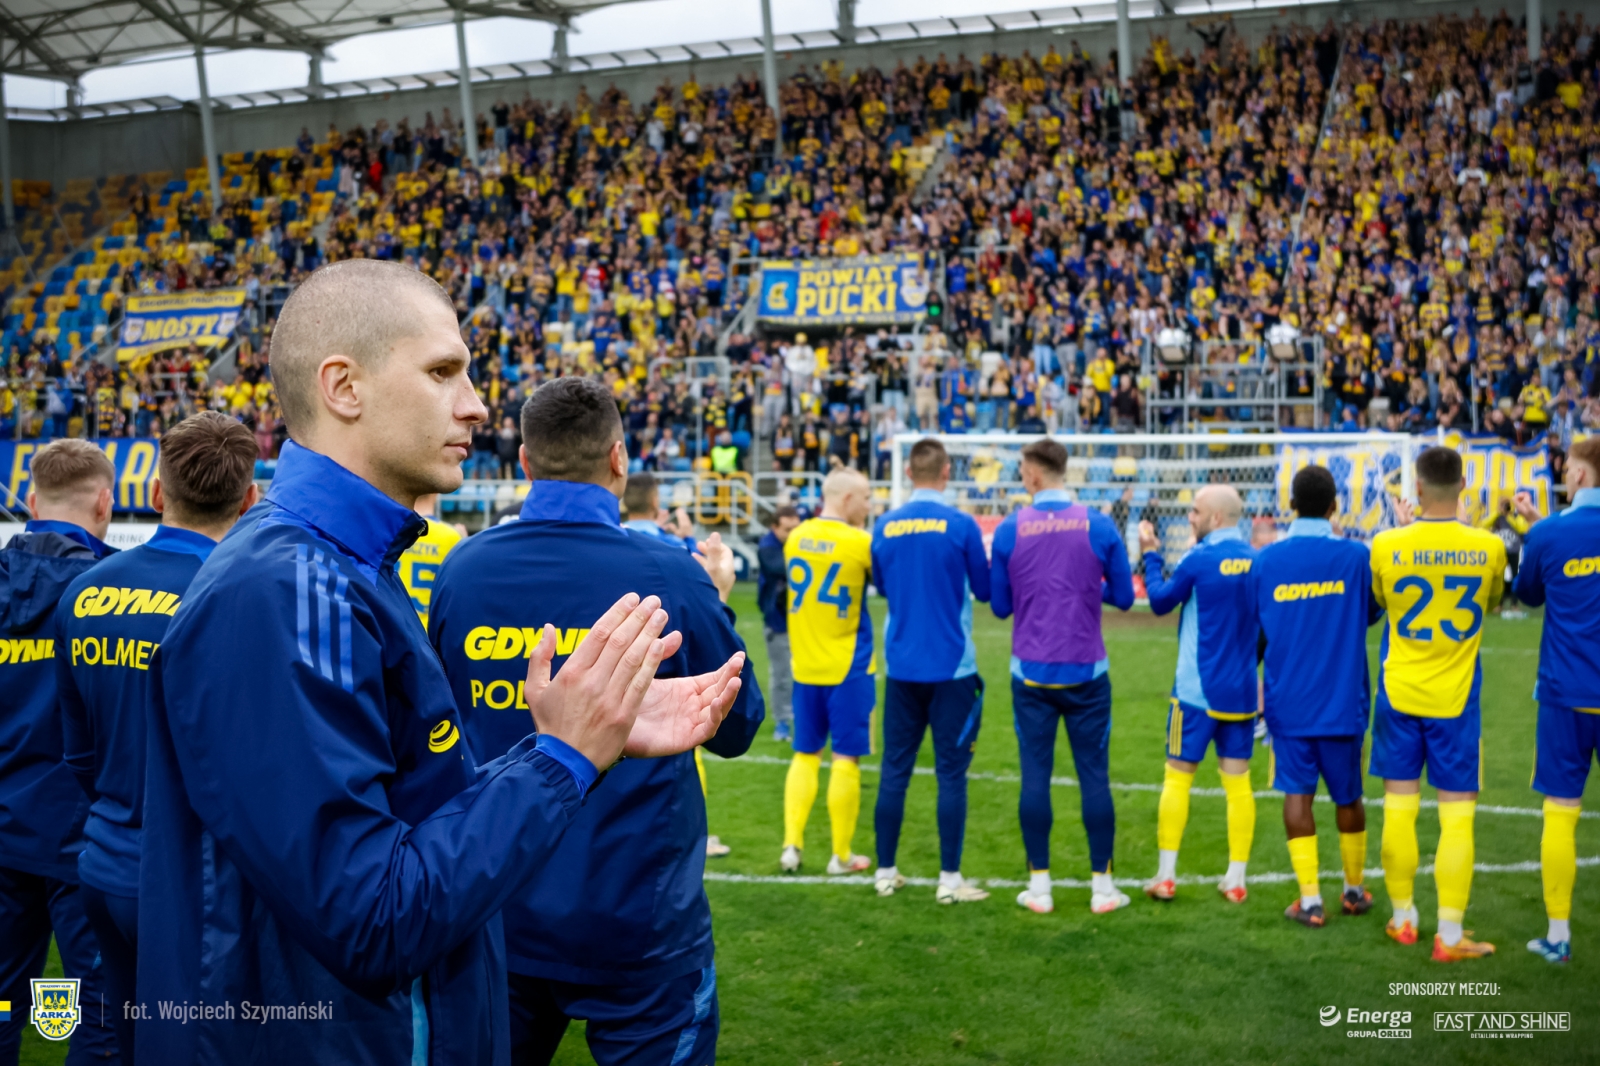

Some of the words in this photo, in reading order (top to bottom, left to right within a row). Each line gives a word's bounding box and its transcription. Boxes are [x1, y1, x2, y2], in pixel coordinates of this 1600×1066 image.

[800, 265, 897, 287] POWIAT
[795, 282, 897, 316] PUCKI
[141, 313, 219, 342] MOSTY
[884, 518, 947, 538] GDYNIA
[1018, 518, 1090, 538] GDYNIA
[405, 541, 439, 556] CZYK
[1393, 550, 1407, 566] K.
[1413, 550, 1488, 566] HERMOSO
[786, 557, 852, 618] 94
[1274, 580, 1345, 602] GDYNIA
[1394, 575, 1483, 642] 23
[71, 636, 161, 670] POLME
